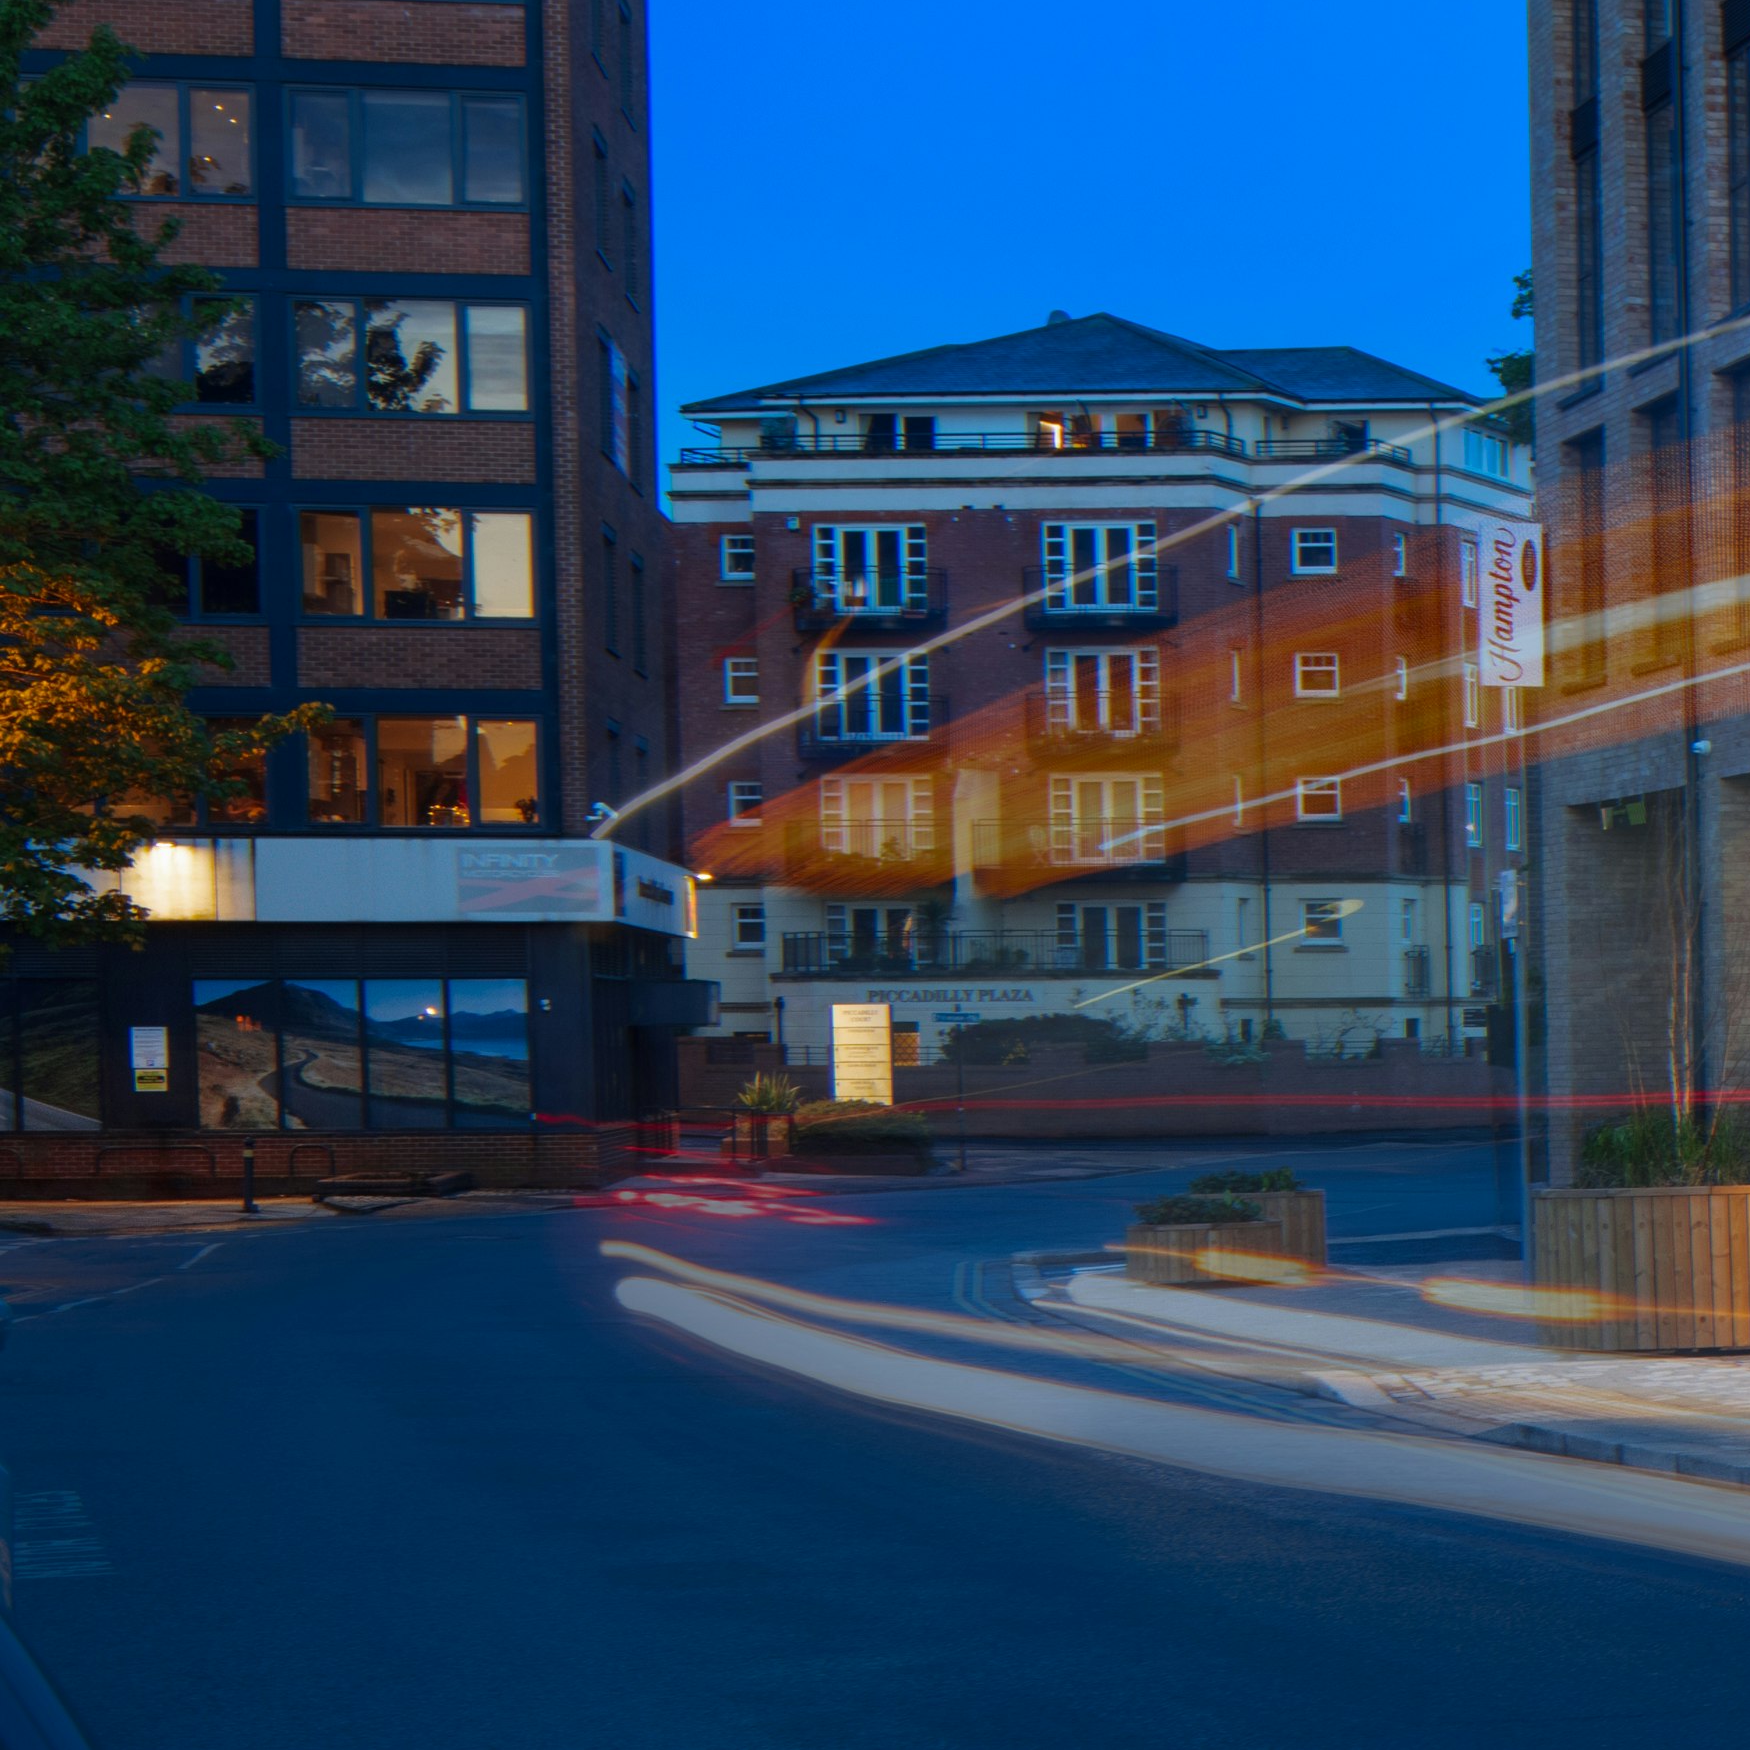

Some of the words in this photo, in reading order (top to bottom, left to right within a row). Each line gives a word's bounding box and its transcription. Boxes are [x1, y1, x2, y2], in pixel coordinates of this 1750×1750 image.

[1487, 527, 1524, 682] Hampton
[461, 853, 559, 868] INFINITY
[867, 989, 975, 1002] PICCADILLY
[977, 989, 1034, 1002] PLAZA
